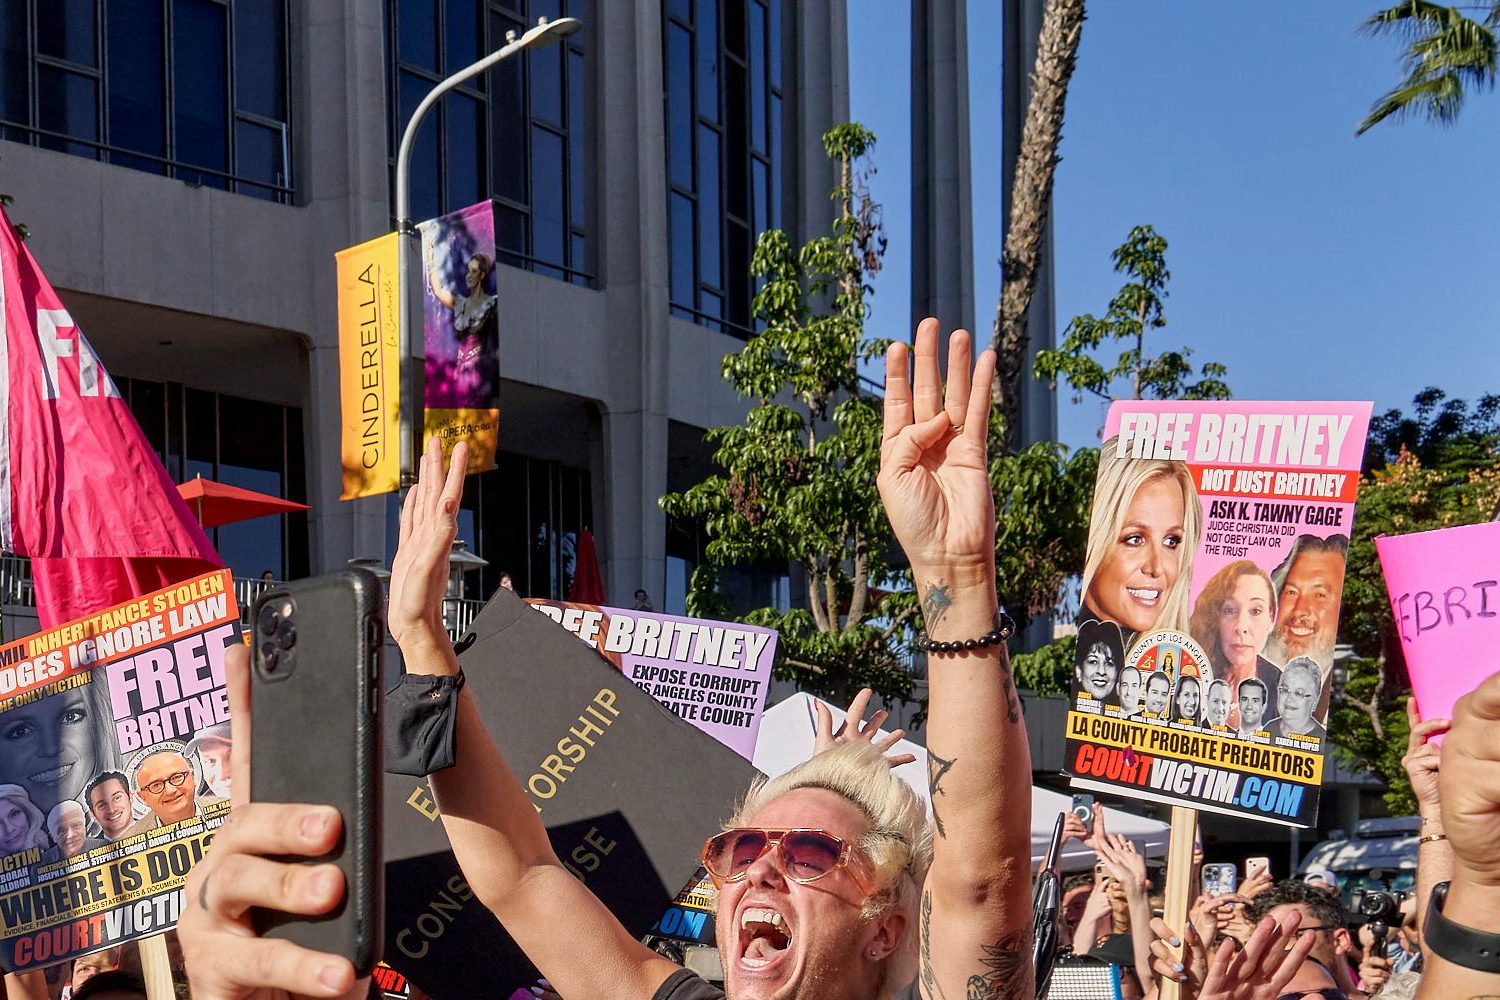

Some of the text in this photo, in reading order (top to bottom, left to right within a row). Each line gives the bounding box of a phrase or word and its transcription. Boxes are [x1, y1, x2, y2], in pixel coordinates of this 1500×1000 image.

[358, 263, 379, 469] CINDERELLA
[1115, 412, 1354, 467] FREE BRITNEY
[1200, 468, 1347, 498] NOT JUST BRITNEY
[1207, 520, 1296, 537] JUDGE CHRISTIAN DID
[1209, 500, 1343, 527] ASK K. TAWNY GAGE
[1204, 544, 1248, 558] THE TRUST
[1206, 533, 1281, 548] NOT OBEY LAW OR
[29, 602, 150, 658] INHERITANCE
[154, 574, 225, 612] STOLEN
[69, 615, 166, 670] IGNORE
[169, 593, 227, 632] LAW
[1393, 580, 1498, 642] EBRI
[604, 614, 771, 671] BRITNEY
[1130, 634, 1209, 676] COUNTY OF LOS ANGELES
[15, 687, 43, 708] ONLY
[43, 671, 92, 700] VICTIM!
[632, 664, 761, 696] EXPOSE CORRUPT
[652, 685, 704, 703] ANGELES
[707, 691, 758, 710] COUNTY
[116, 689, 232, 754] BRITNE
[700, 706, 755, 728] COURT
[1072, 716, 1088, 736] LA
[1091, 719, 1148, 747] COUNTY
[1150, 729, 1217, 761] PROBATE
[1221, 742, 1315, 779] PREDATORS
[1074, 743, 1306, 817] COURTVICTIM.COM
[0, 869, 107, 929] WHERE
[110, 858, 143, 896] IS
[73, 904, 100, 917] WITNESS
[100, 890, 140, 908] STATEMENTS
[147, 876, 188, 893] DOCUMENTA
[13, 888, 187, 967] COURTVICTI
